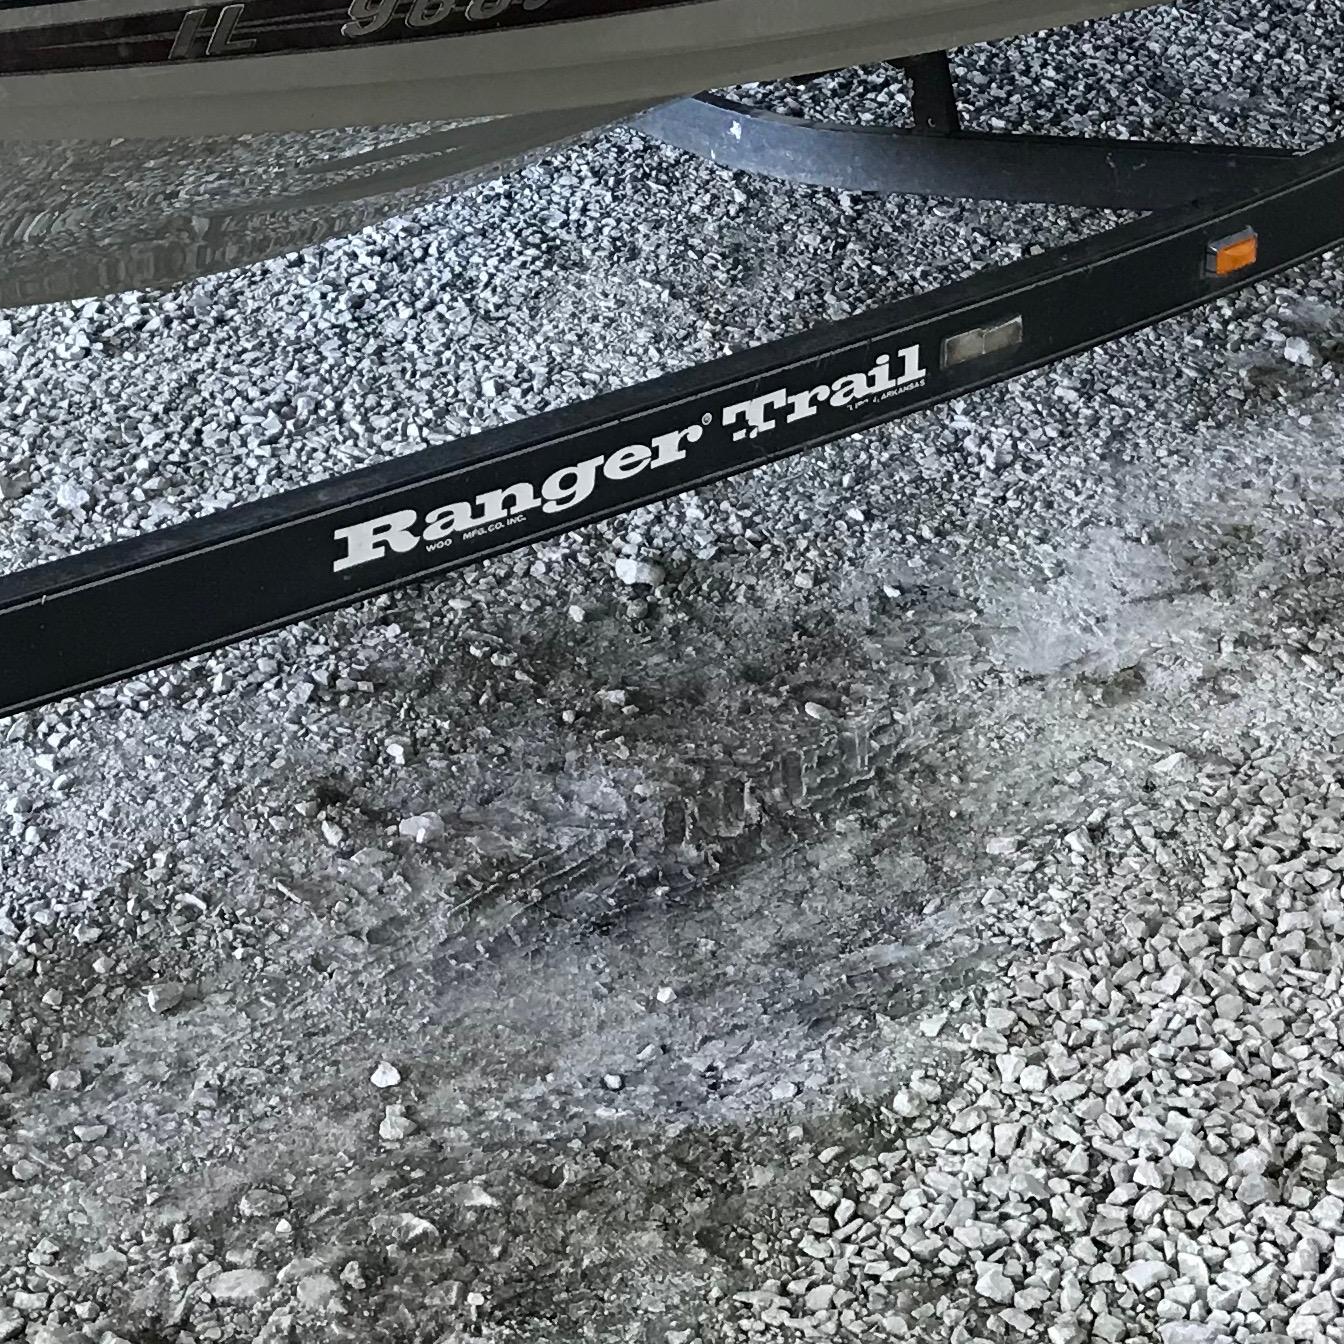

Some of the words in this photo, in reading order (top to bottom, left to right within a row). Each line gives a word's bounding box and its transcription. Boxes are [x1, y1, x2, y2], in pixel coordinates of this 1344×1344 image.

[168, 3, 257, 60] IL
[332, 422, 703, 573] Ranger
[722, 344, 927, 442] Trail
